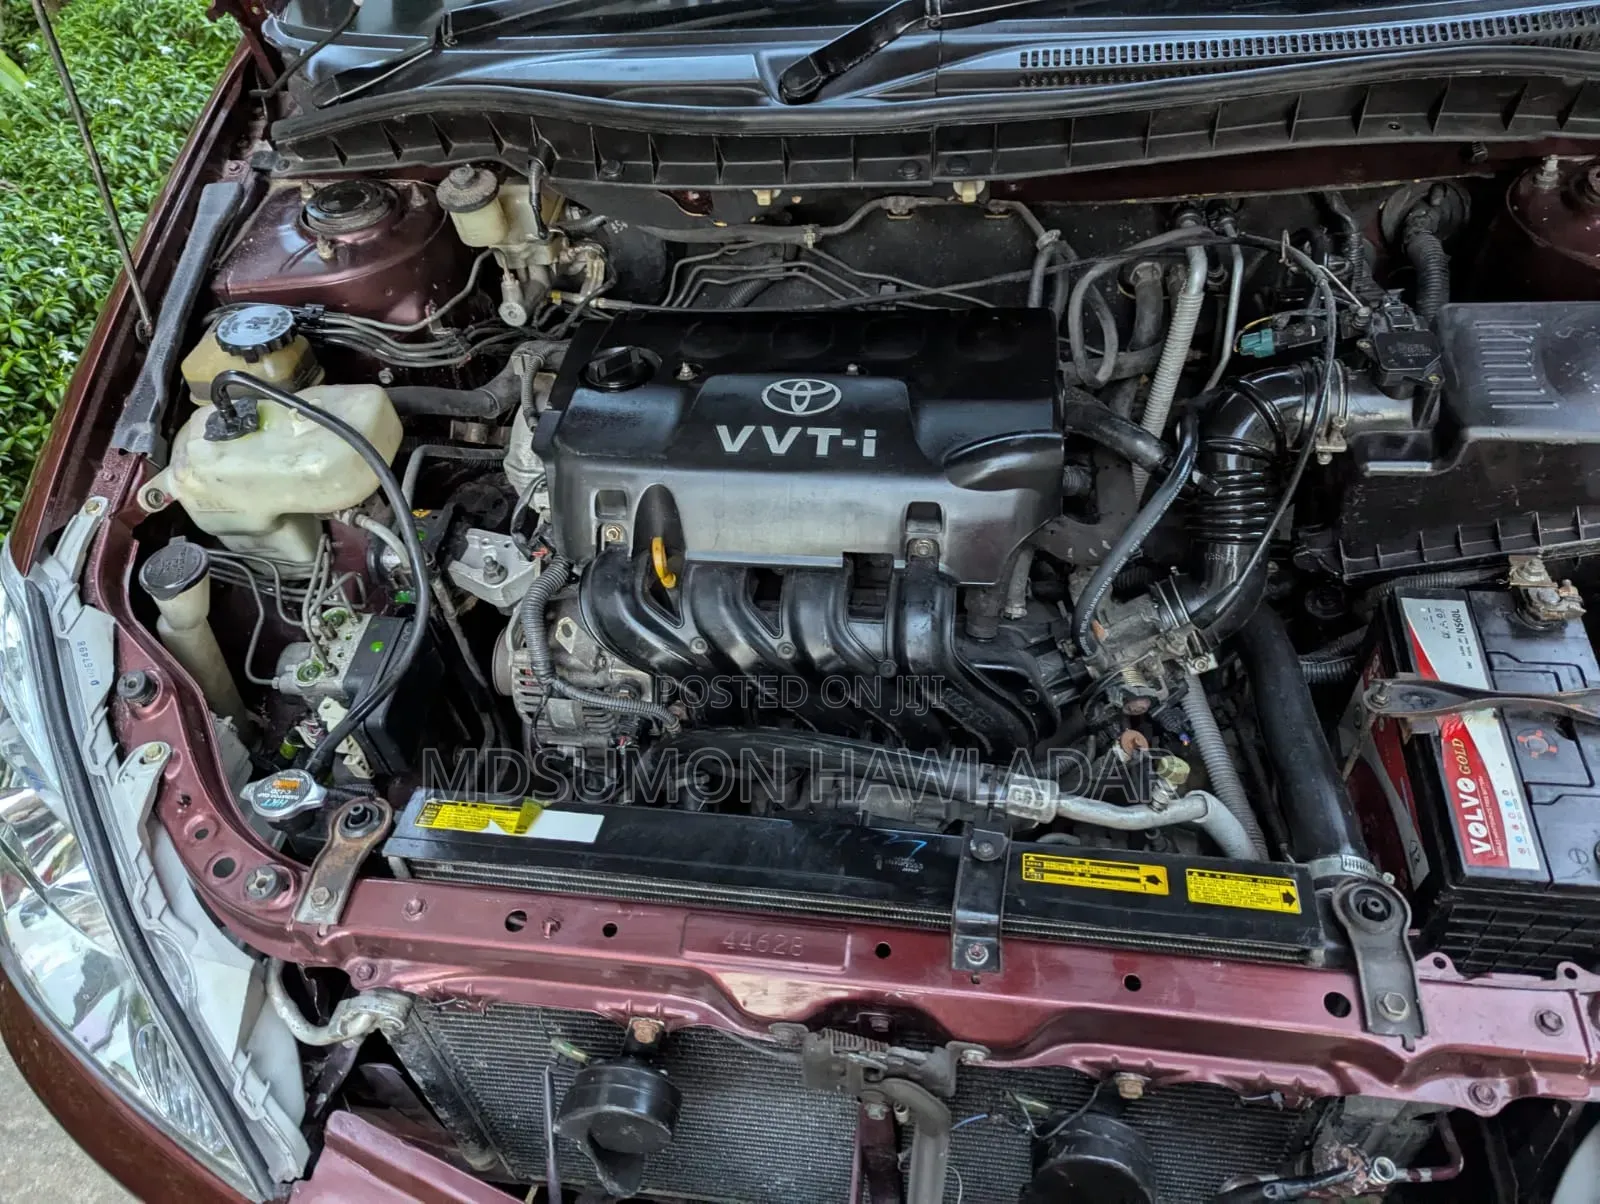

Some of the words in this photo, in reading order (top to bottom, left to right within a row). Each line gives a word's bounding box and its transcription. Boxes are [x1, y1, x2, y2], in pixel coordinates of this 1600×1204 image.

[716, 424, 877, 457] VVT-i
[1451, 608, 1466, 635] NS60L
[1452, 737, 1472, 775] GOLD
[1456, 777, 1492, 855] VOLVO
